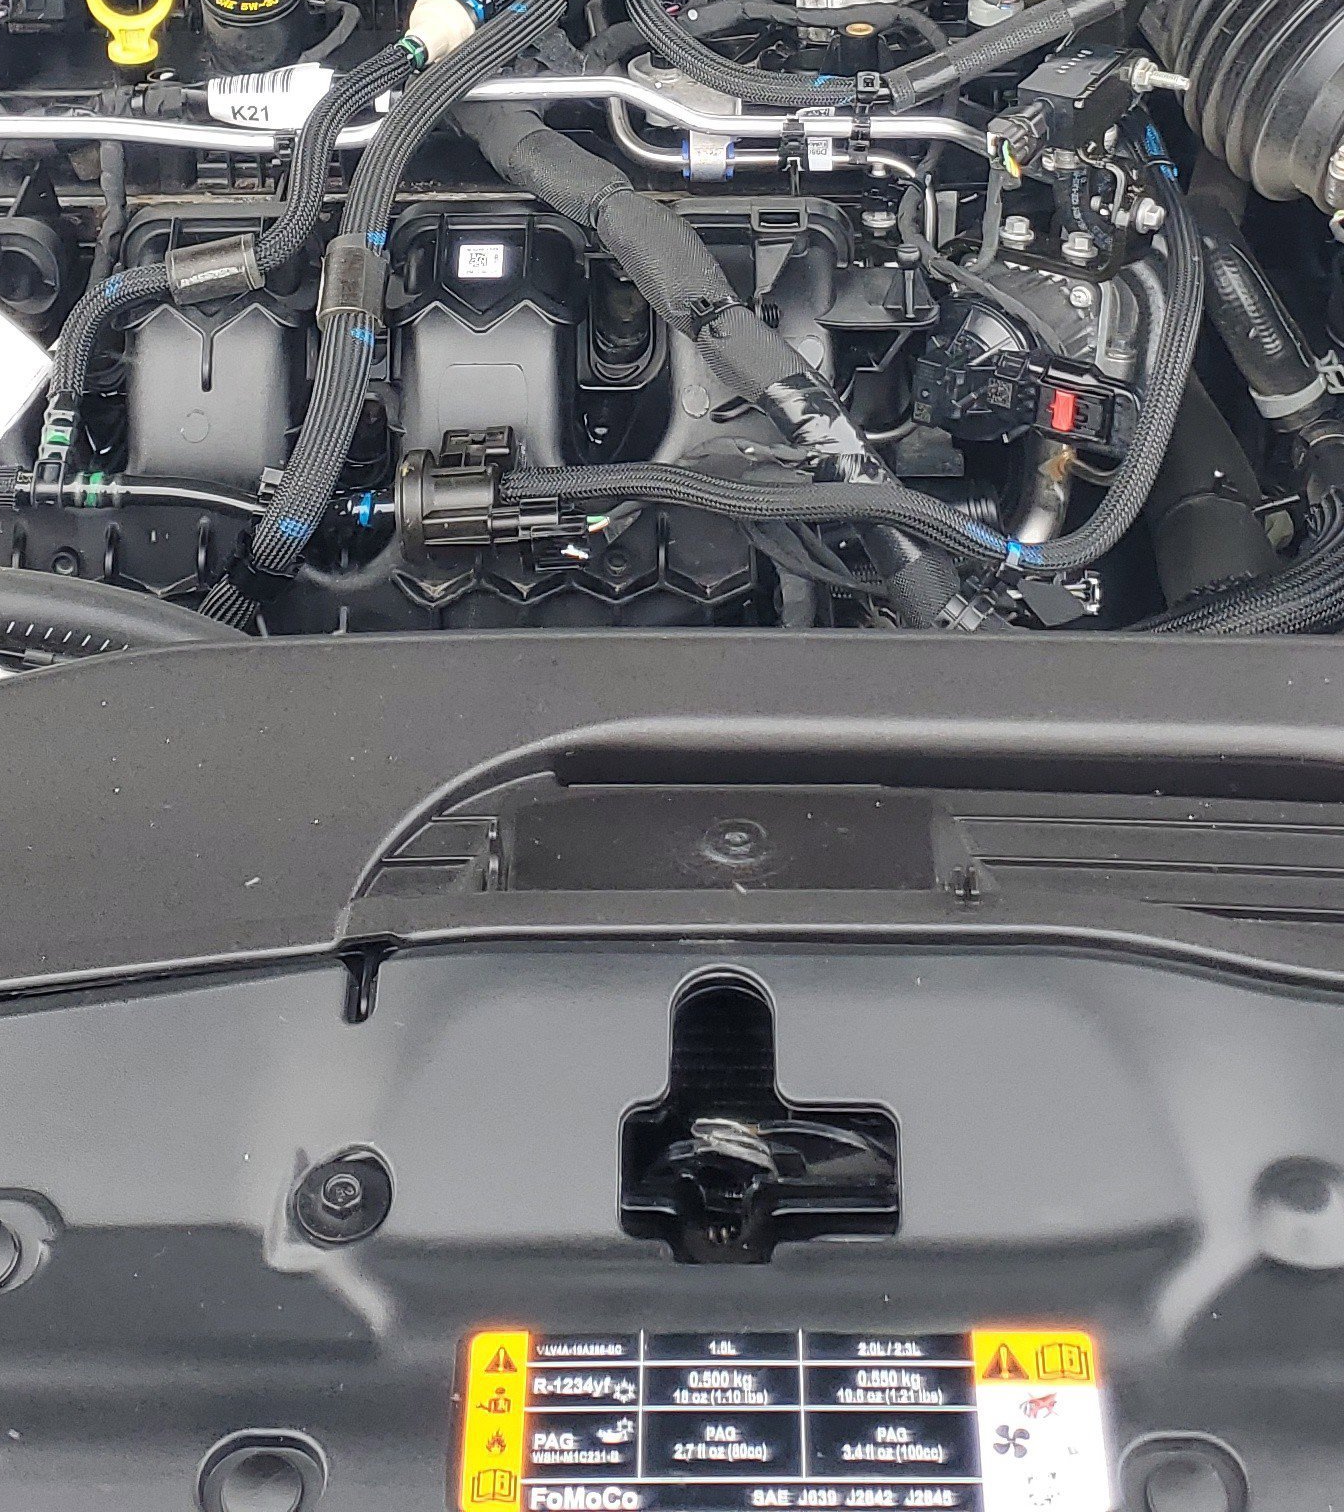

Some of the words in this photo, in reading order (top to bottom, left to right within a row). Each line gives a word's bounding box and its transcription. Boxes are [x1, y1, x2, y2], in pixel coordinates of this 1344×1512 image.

[231, 105, 269, 121] K21
[533, 1376, 611, 1397] R-1234yf
[689, 1370, 729, 1388] 0.500
[733, 1369, 753, 1390] kg
[901, 1369, 921, 1390] kg
[691, 1391, 708, 1403] oz
[710, 1388, 741, 1406] (1.10
[744, 1388, 769, 1405] lbs)
[866, 1391, 884, 1403] oz
[885, 1388, 915, 1405] (1.21
[918, 1388, 943, 1405] lbs)
[534, 1433, 574, 1450] PAG
[706, 1425, 736, 1441] PAG
[876, 1426, 908, 1442] PAG
[673, 1443, 695, 1459] 2.7
[708, 1446, 726, 1459] oz
[842, 1443, 863, 1460] 3.4
[865, 1443, 875, 1460] fl
[877, 1447, 894, 1460] oz
[896, 1443, 943, 1463] (100cc)
[529, 1486, 638, 1511] FoMoCo
[752, 1489, 789, 1506] SAE
